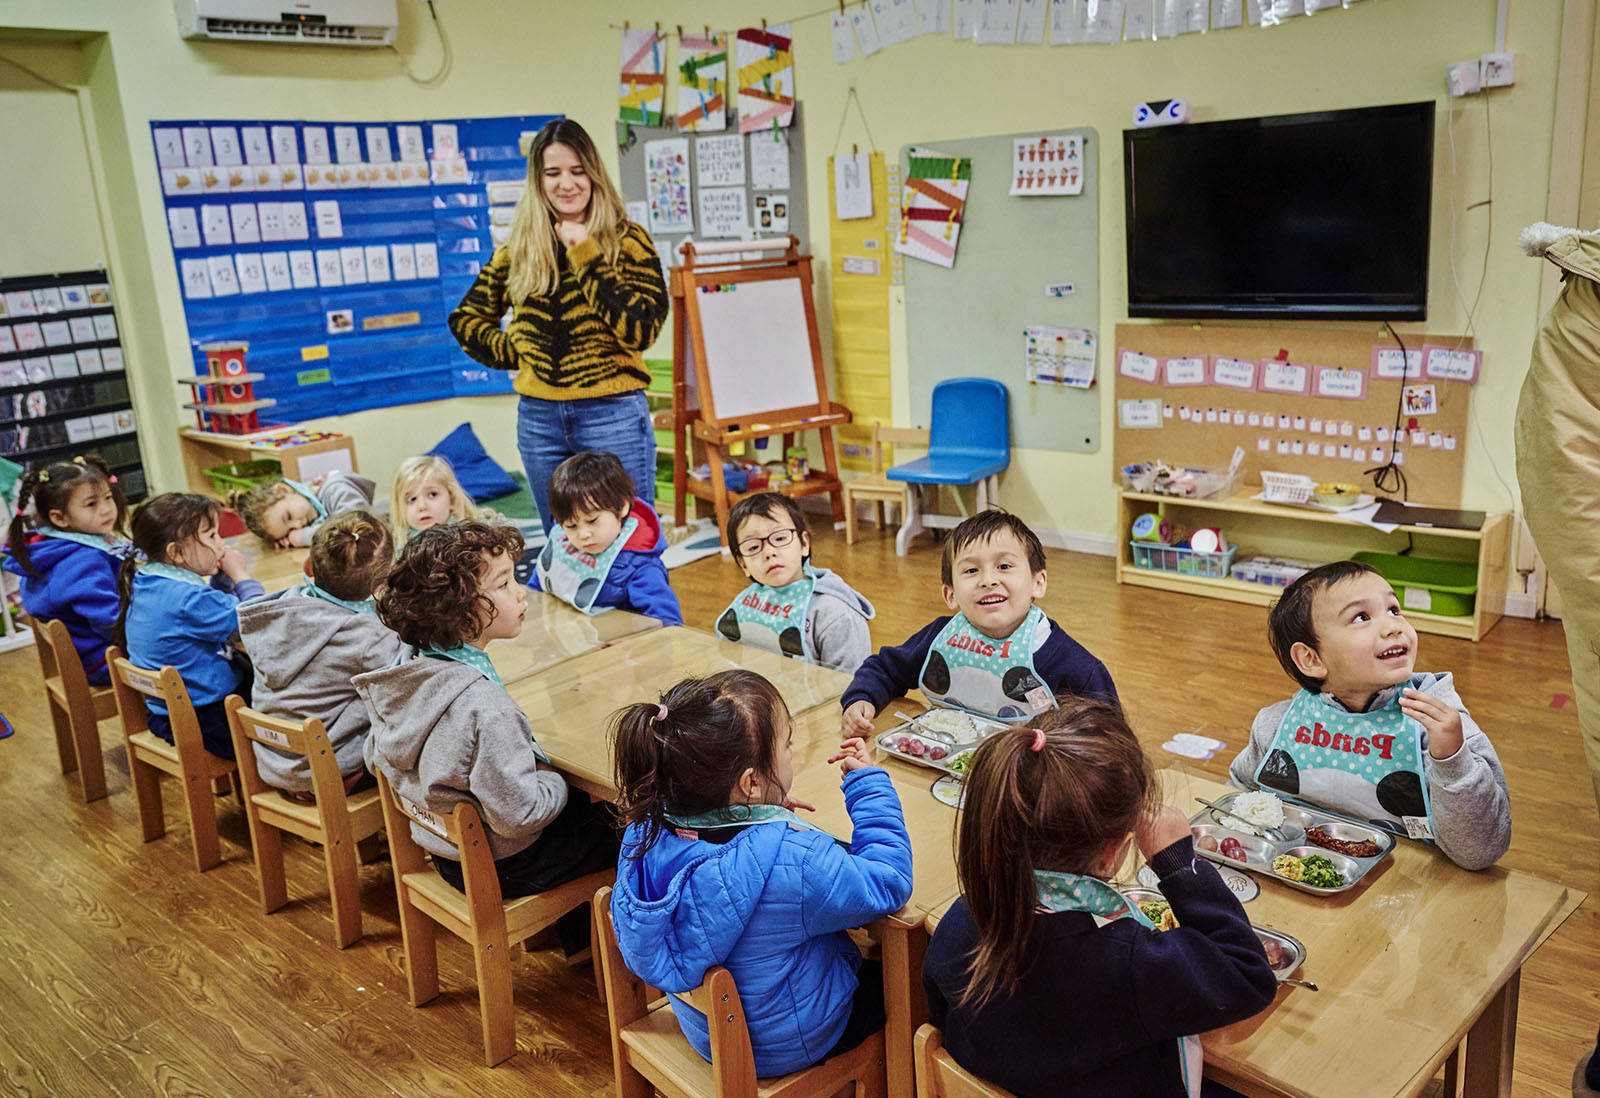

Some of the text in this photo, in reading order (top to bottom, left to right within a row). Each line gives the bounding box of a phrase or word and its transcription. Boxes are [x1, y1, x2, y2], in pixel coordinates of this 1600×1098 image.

[193, 138, 203, 155] 2
[222, 138, 232, 154] 3
[281, 136, 290, 153] 5
[312, 138, 322, 156] 6
[374, 138, 384, 153] 8
[407, 136, 417, 155] 9
[440, 135, 454, 150] 10
[190, 253, 434, 285] 11 12 13 14 15 16 17 18 19 20
[1388, 351, 1415, 360] SAMDI
